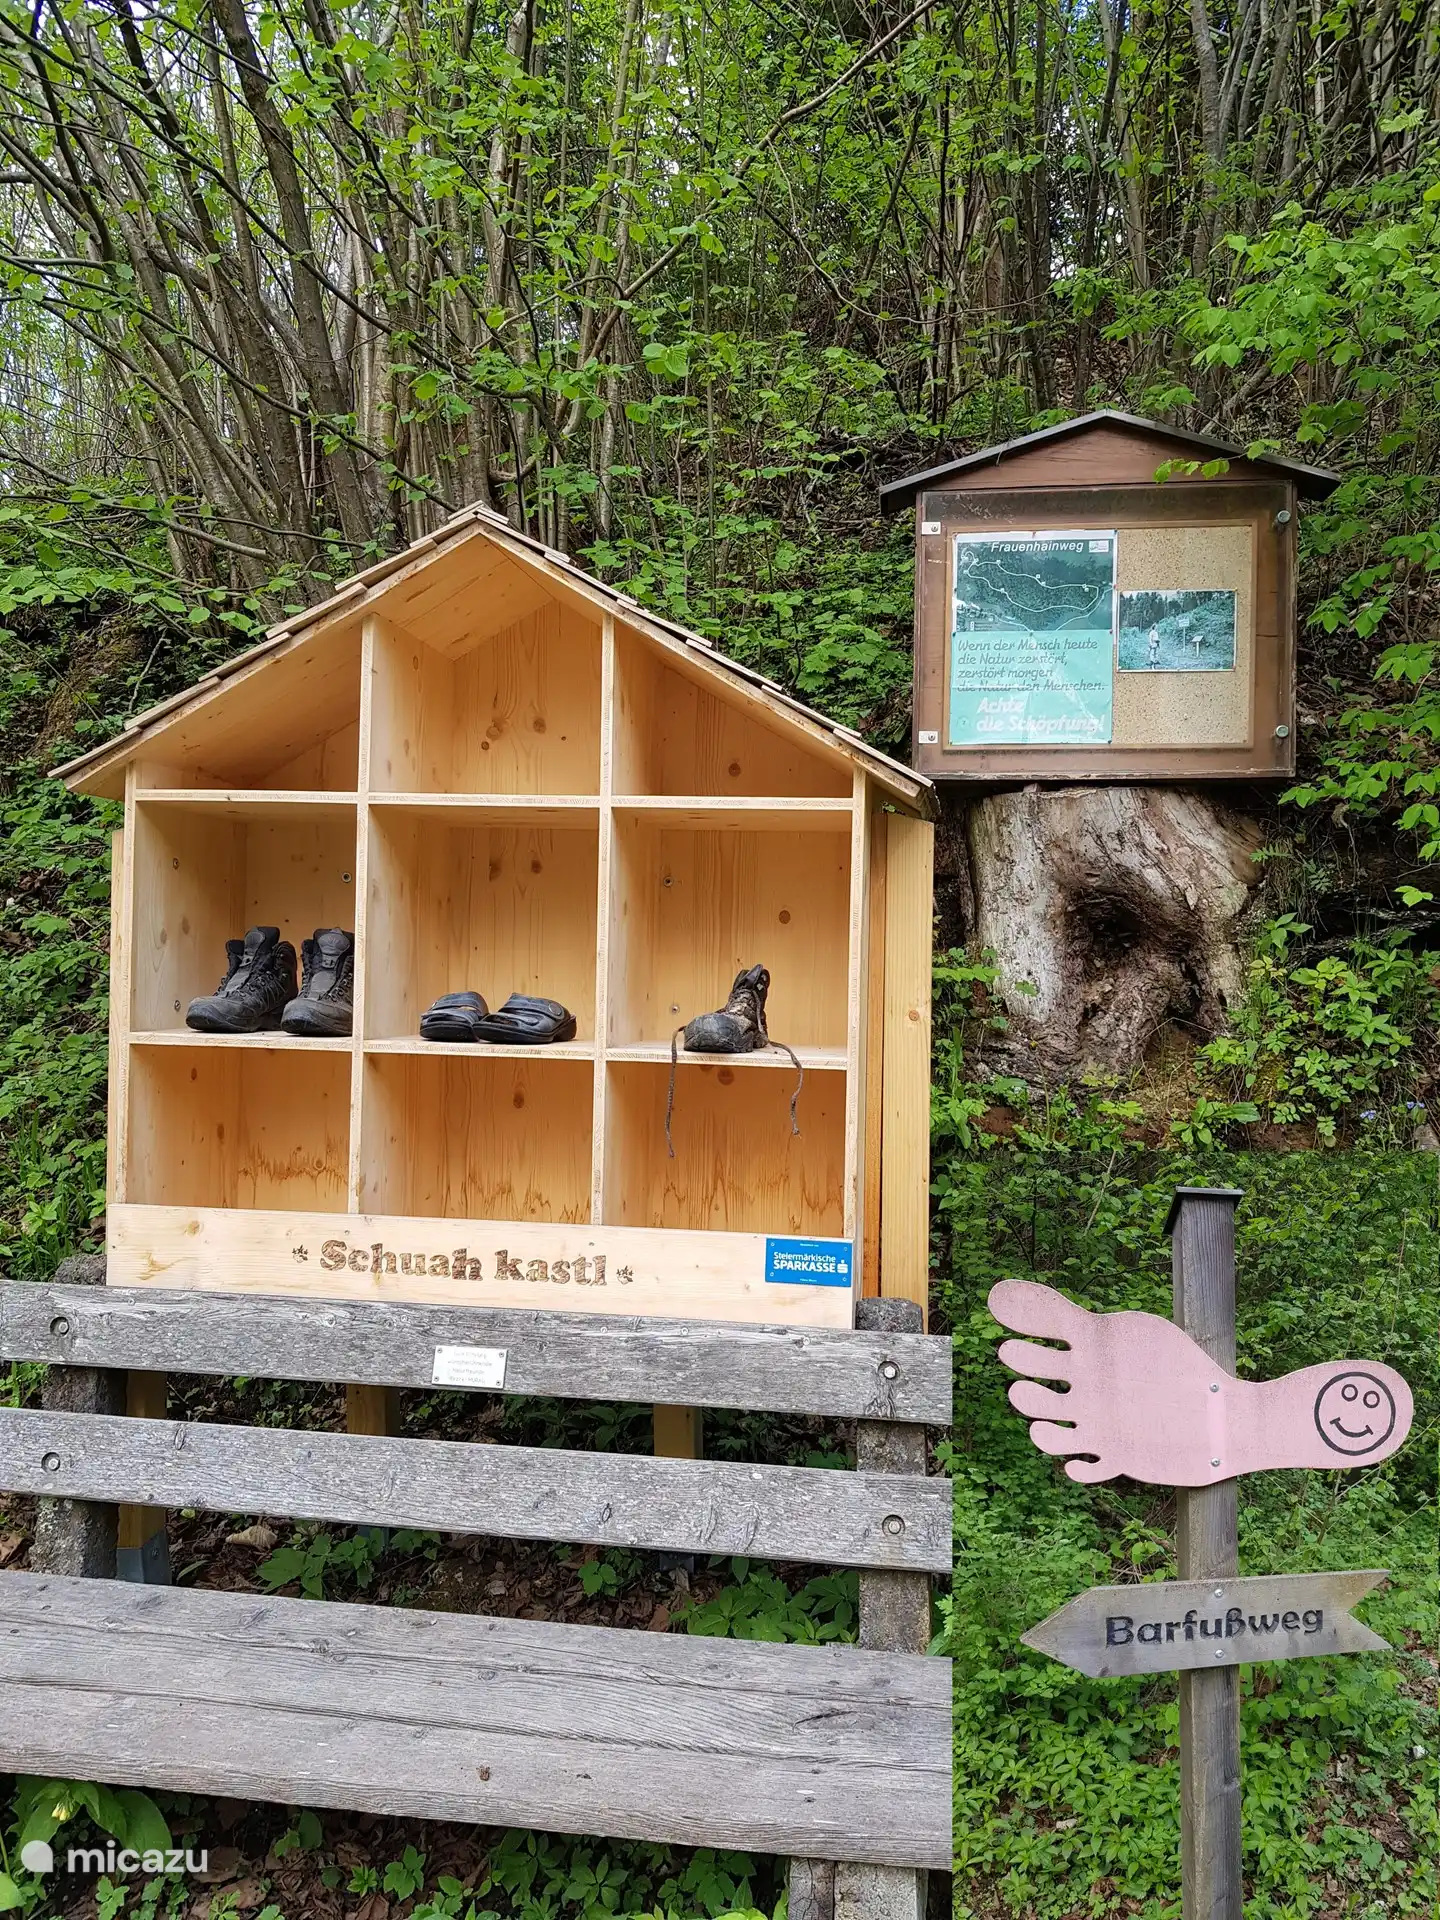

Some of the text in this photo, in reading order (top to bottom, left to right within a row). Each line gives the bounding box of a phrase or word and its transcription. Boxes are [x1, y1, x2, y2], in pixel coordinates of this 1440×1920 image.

[991, 541, 1084, 552] Frauenhainweg
[957, 638, 1098, 651] Wenn der Mensch heute
[957, 652, 1068, 666] die Natur zerstört,
[957, 668, 1053, 681] zerstört morgen
[1017, 681, 1040, 691] den
[976, 697, 1025, 714] Achte
[976, 714, 1105, 737] die Schöpfung!
[320, 1239, 608, 1287] Schuah kastl
[773, 1251, 836, 1263] Steiermärkische
[773, 1259, 836, 1273] SPARKASSE
[1105, 1607, 1324, 1648] Barfußweg
